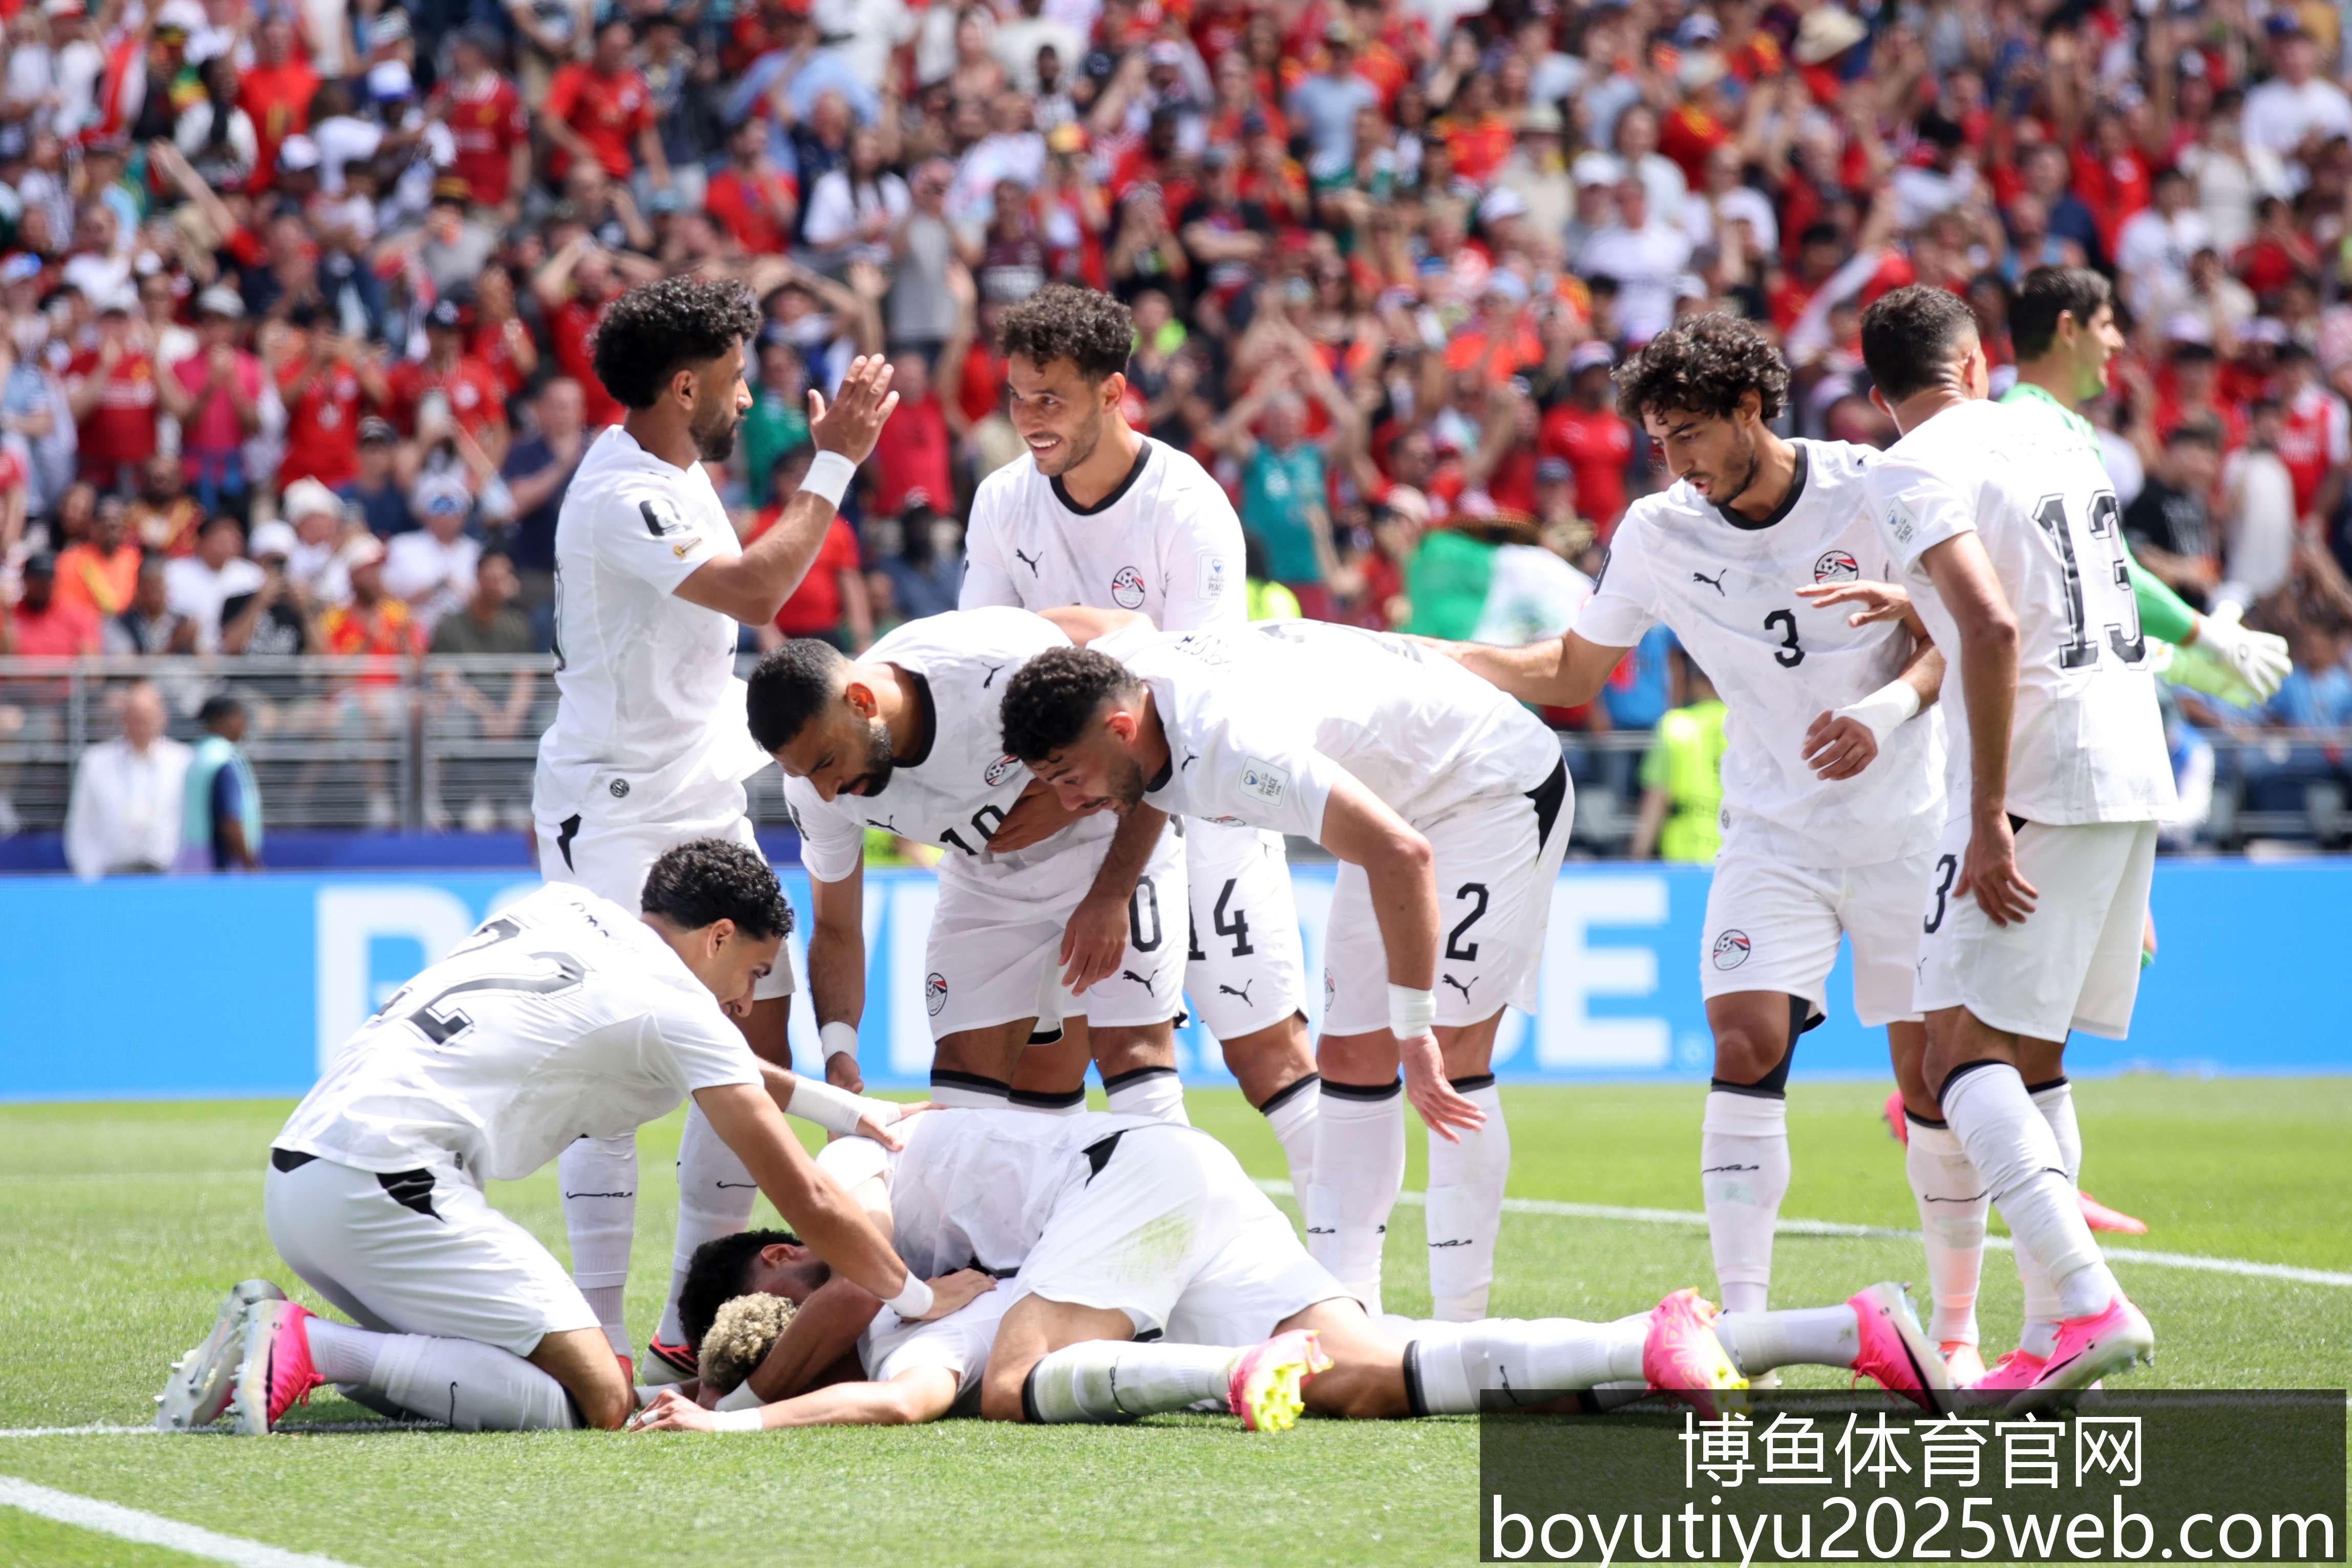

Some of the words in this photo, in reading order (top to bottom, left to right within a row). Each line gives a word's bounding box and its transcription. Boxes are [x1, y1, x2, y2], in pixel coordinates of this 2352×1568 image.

[1209, 583, 1224, 592] PEAC
[2032, 489, 2149, 674] 13
[1764, 609, 1805, 668] 3
[1265, 776, 1279, 797] PEACE
[939, 803, 1005, 856] 10
[1445, 882, 1489, 961] 2
[370, 914, 599, 1053] 22
